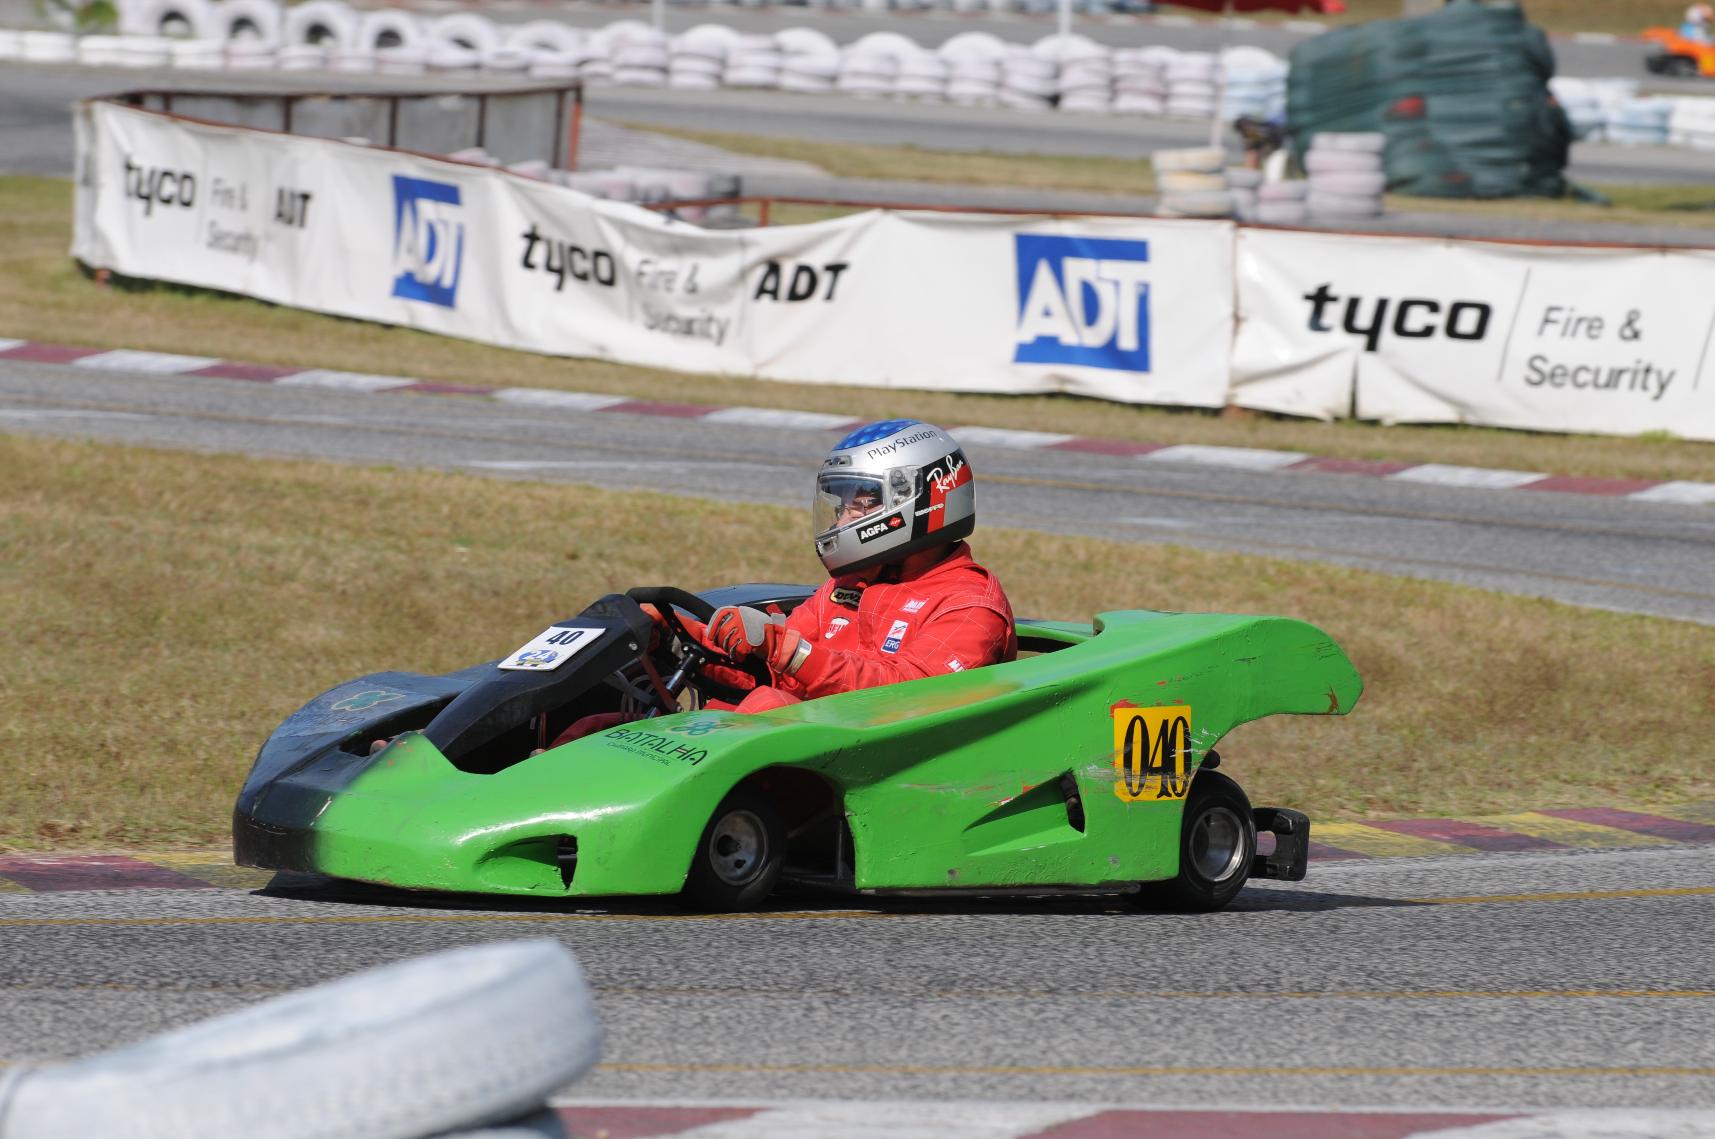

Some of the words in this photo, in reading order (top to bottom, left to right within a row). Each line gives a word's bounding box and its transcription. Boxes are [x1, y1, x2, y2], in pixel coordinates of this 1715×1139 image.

[124, 156, 196, 216] tyco
[392, 197, 463, 289] ADT
[519, 222, 616, 293] tyco
[637, 257, 679, 294] Fire
[754, 260, 850, 302] ADT
[1015, 256, 1151, 352] ADT
[1302, 281, 1494, 353] tyco
[1536, 305, 1605, 341] Fire
[1618, 308, 1644, 343] &
[1523, 354, 1678, 401] Security
[867, 429, 939, 460] PlayStation
[860, 522, 889, 540] AGFA
[545, 630, 585, 646] 40
[885, 639, 901, 650] ERG
[605, 728, 708, 766] BATALHA
[1122, 714, 1193, 799] 040
